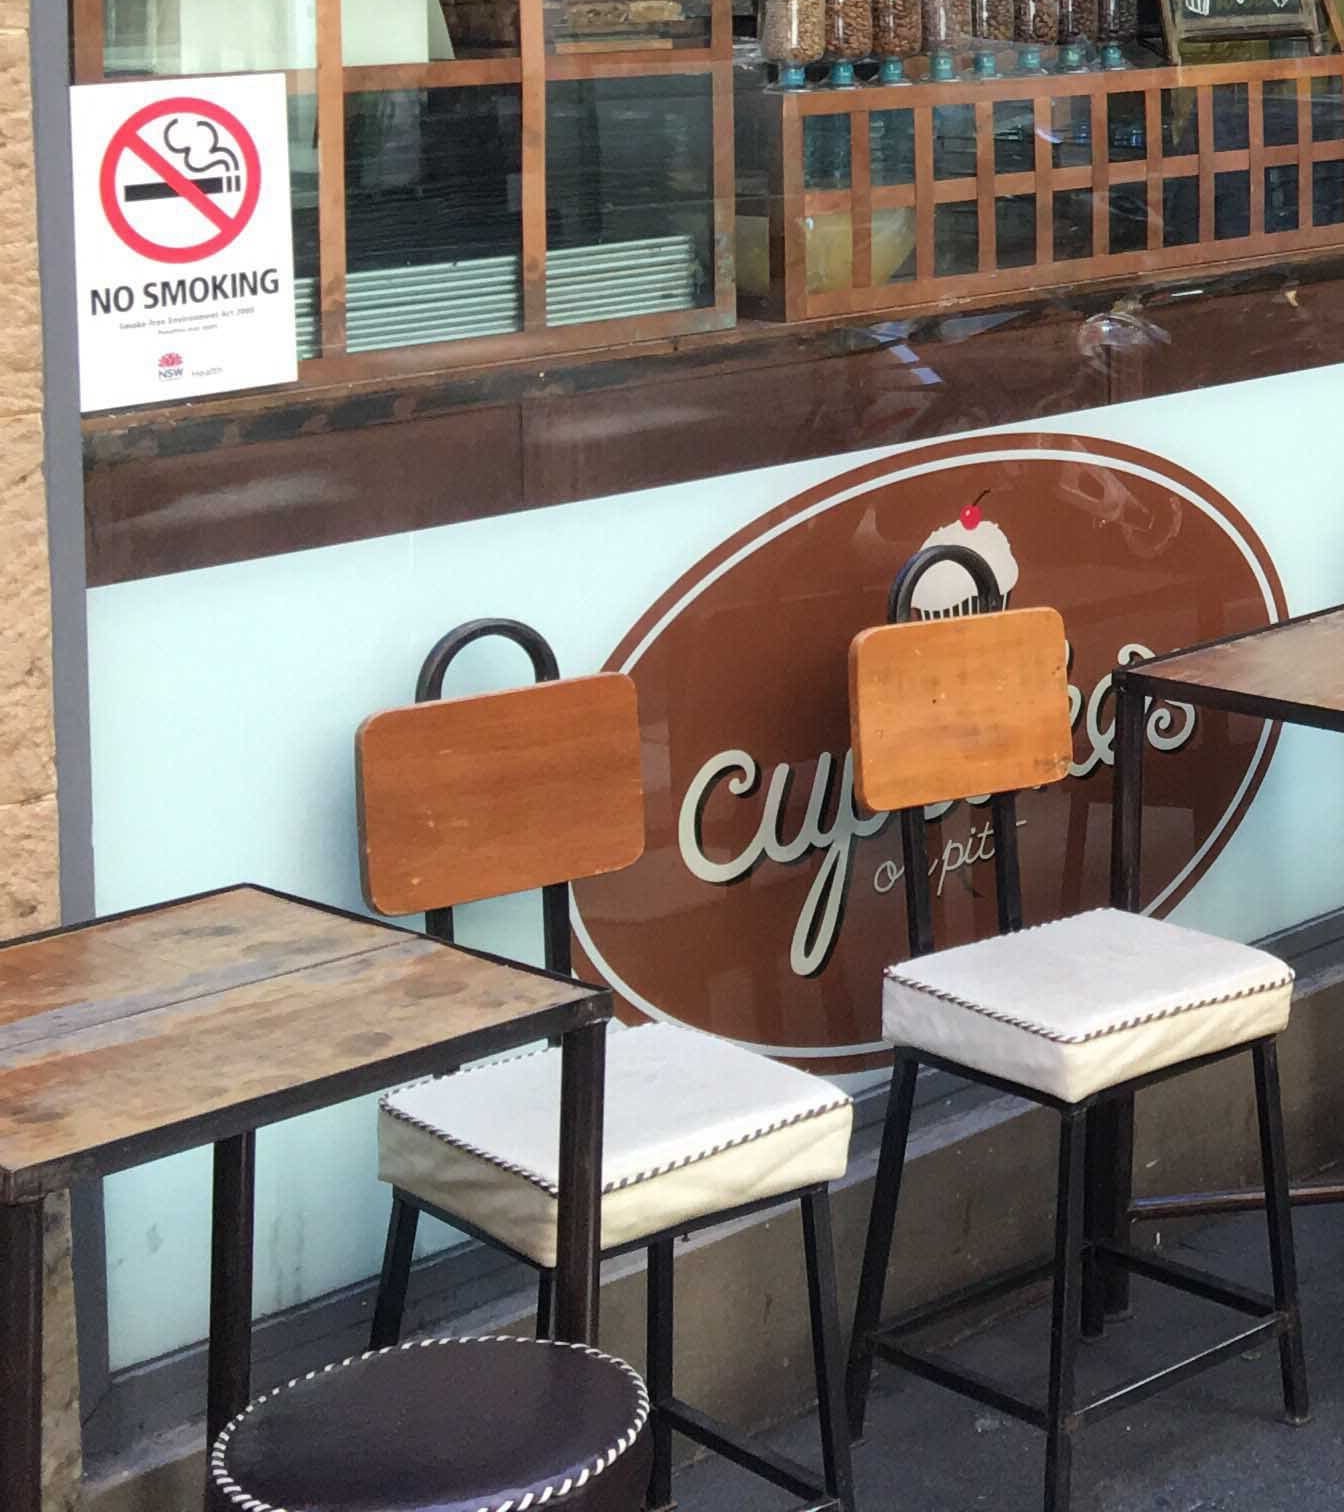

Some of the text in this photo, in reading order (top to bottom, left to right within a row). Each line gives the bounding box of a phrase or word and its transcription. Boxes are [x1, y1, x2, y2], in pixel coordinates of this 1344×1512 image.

[90, 268, 280, 316] NO SMOKING
[158, 368, 184, 379] NSW
